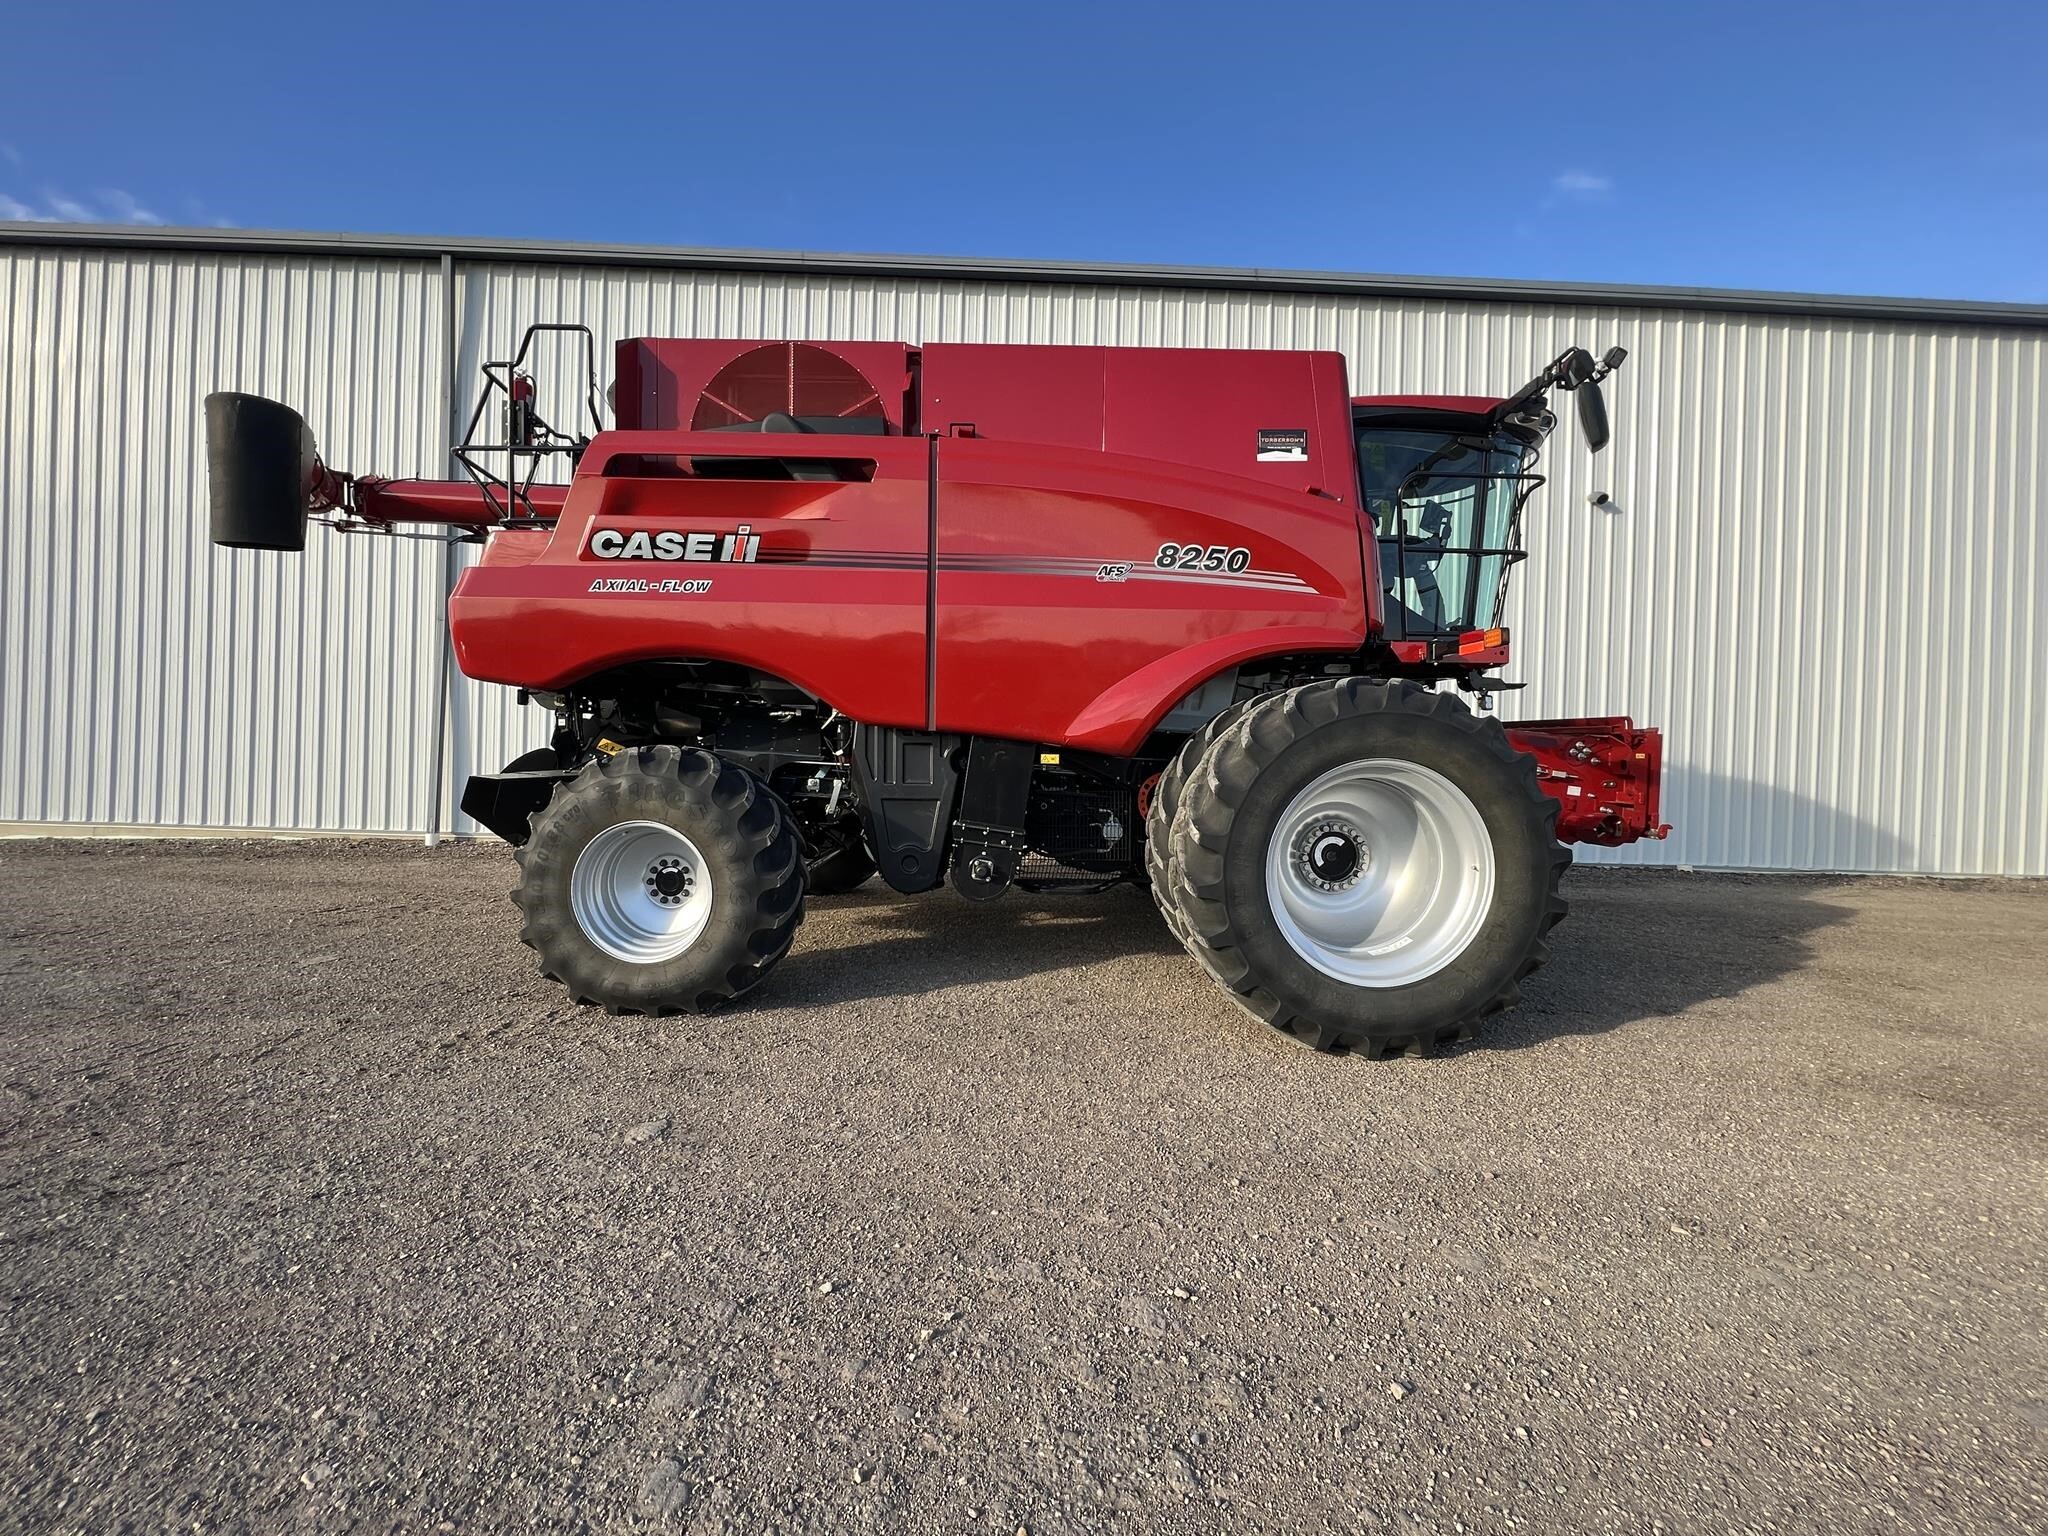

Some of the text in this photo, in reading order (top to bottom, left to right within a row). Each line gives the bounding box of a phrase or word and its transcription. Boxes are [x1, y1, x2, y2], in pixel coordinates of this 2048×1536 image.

[590, 529, 716, 561] CASE
[1155, 543, 1250, 574] 8250
[1097, 564, 1127, 577] AFS
[588, 579, 712, 593] AXIAL-FLOW
